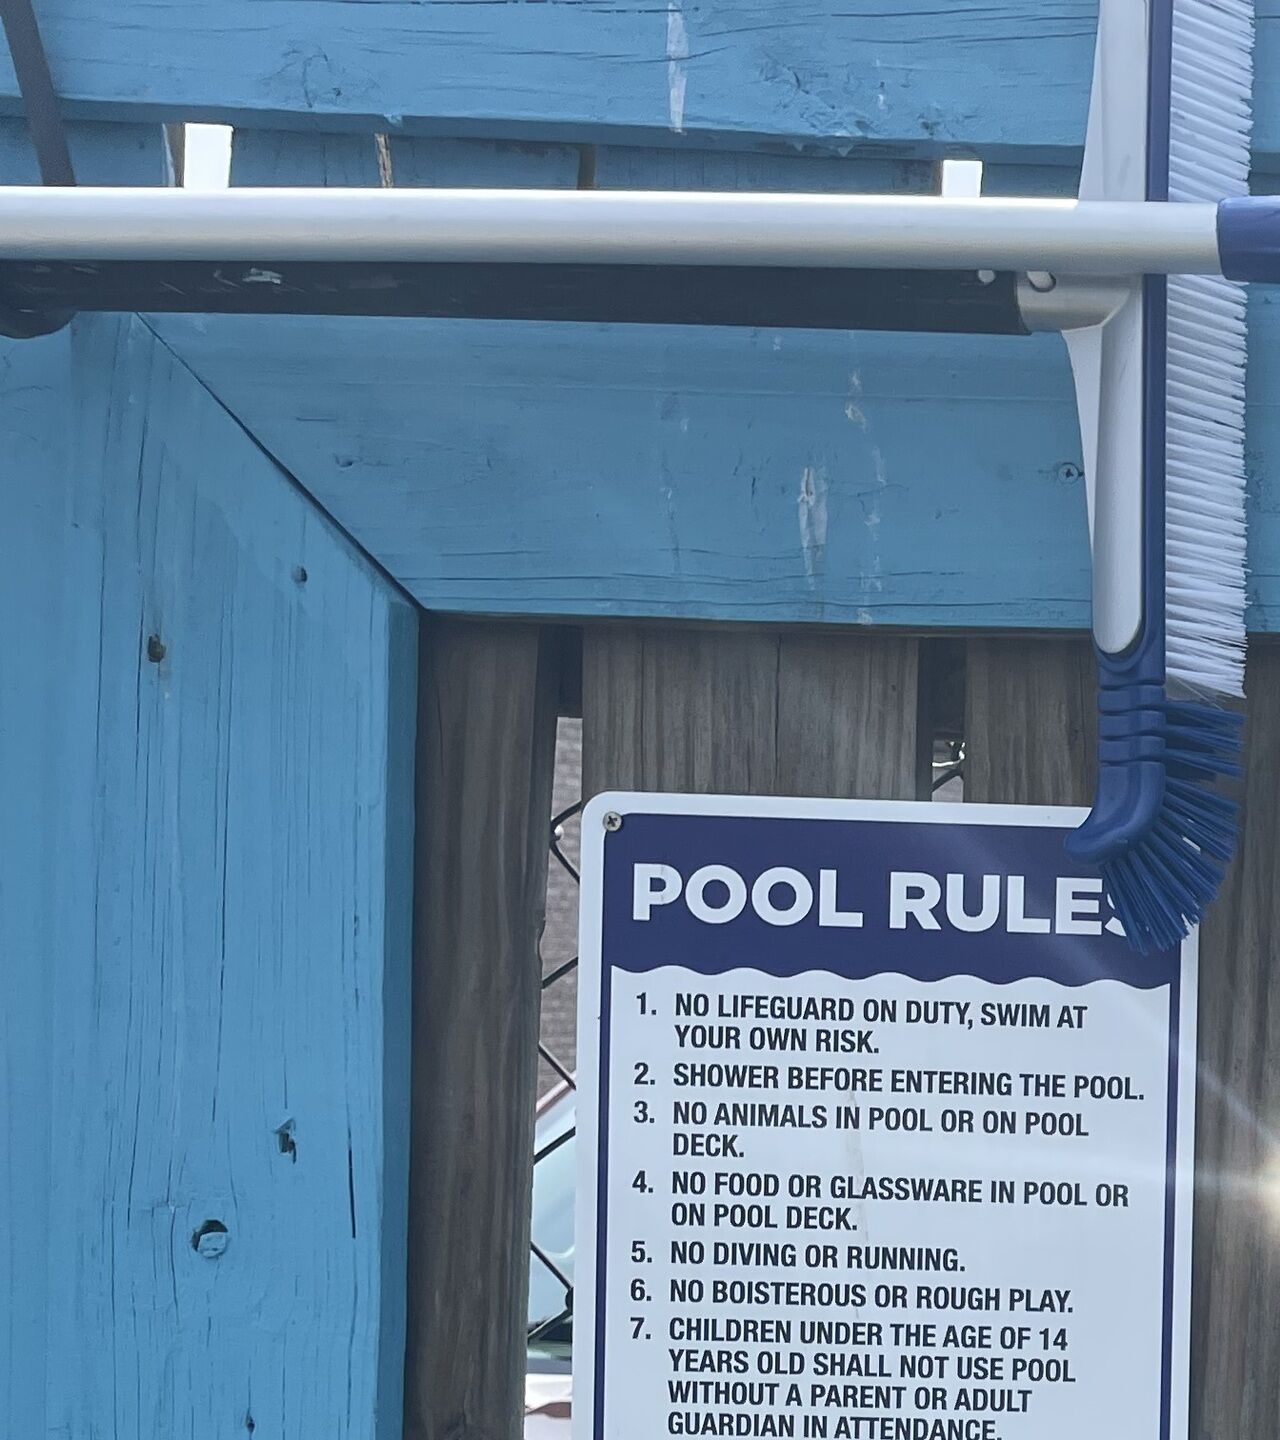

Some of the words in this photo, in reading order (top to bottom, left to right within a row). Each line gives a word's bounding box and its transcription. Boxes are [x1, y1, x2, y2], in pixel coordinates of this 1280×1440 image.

[631, 862, 863, 928] POOL
[889, 871, 1126, 937] RULE
[636, 992, 657, 1016] 1.
[675, 992, 710, 1017] NO
[718, 994, 855, 1022] LIFEGUARD
[863, 998, 897, 1023] ON
[905, 1000, 973, 1031] DUTY,
[980, 1002, 1051, 1028] SWIM
[1056, 1005, 1088, 1029] AT
[674, 1024, 741, 1050] YOUR
[749, 1026, 807, 1052] OWN
[815, 1028, 879, 1054] RISK.
[633, 1062, 656, 1086] 2.
[673, 1062, 779, 1089] SHOWER
[787, 1066, 883, 1092] BEFORE
[890, 1069, 1012, 1096] ENTERING
[1019, 1073, 1066, 1098] THE
[1073, 1075, 1145, 1101] POOL.
[633, 1100, 655, 1124] 3.
[673, 1101, 707, 1125] NO
[713, 1102, 828, 1129] ANIMALS
[835, 1105, 860, 1130] IN
[868, 1106, 933, 1132] POOL
[941, 1109, 974, 1133] OR
[982, 1110, 1017, 1134] ON
[1025, 1111, 1089, 1137] POOL
[673, 1132, 745, 1158] DECK.
[631, 1170, 654, 1194] 4.
[672, 1171, 706, 1195] NO
[714, 1172, 780, 1197] FOOD
[788, 1174, 821, 1198] OR
[830, 1175, 983, 1203] GLASSWARE
[990, 1180, 1015, 1204] IN
[1023, 1181, 1088, 1206] POOL
[1095, 1183, 1129, 1208] OR
[671, 1202, 706, 1227] ON
[713, 1203, 778, 1229] POOL
[786, 1205, 858, 1231] DECK.
[631, 1240, 653, 1264] 5.
[670, 1240, 705, 1265] NO
[713, 1241, 797, 1267] DIVING
[805, 1244, 838, 1269] OR
[847, 1245, 966, 1272] RUNNING.
[630, 1278, 652, 1302] 6.
[670, 1278, 704, 1303] NO
[712, 1280, 867, 1308] BOISTEROUS
[874, 1284, 908, 1309] OR
[916, 1285, 1001, 1311] ROUGH
[1009, 1288, 1073, 1314] PLAY.
[630, 1316, 651, 1340] 7.
[669, 1317, 792, 1344] CHILDREN
[800, 1320, 883, 1346] UNDER
[889, 1323, 937, 1348] THE
[942, 1324, 992, 1349] AGE
[1000, 1326, 1032, 1350] OF
[1038, 1327, 1068, 1351] 14
[668, 1348, 749, 1374] YEARS
[757, 1350, 805, 1375] OLD
[812, 1352, 892, 1378] SHALL
[900, 1354, 950, 1379] NOT
[957, 1356, 1004, 1381] USE
[1011, 1358, 1076, 1383] POOL
[667, 1380, 780, 1406] WITHOUT
[785, 1383, 803, 1407] A
[810, 1383, 907, 1409] PARENT
[914, 1386, 948, 1411] OR
[953, 1388, 1033, 1413] ADULT
[667, 1411, 795, 1438] GUARDIAN
[803, 1414, 828, 1439] IN
